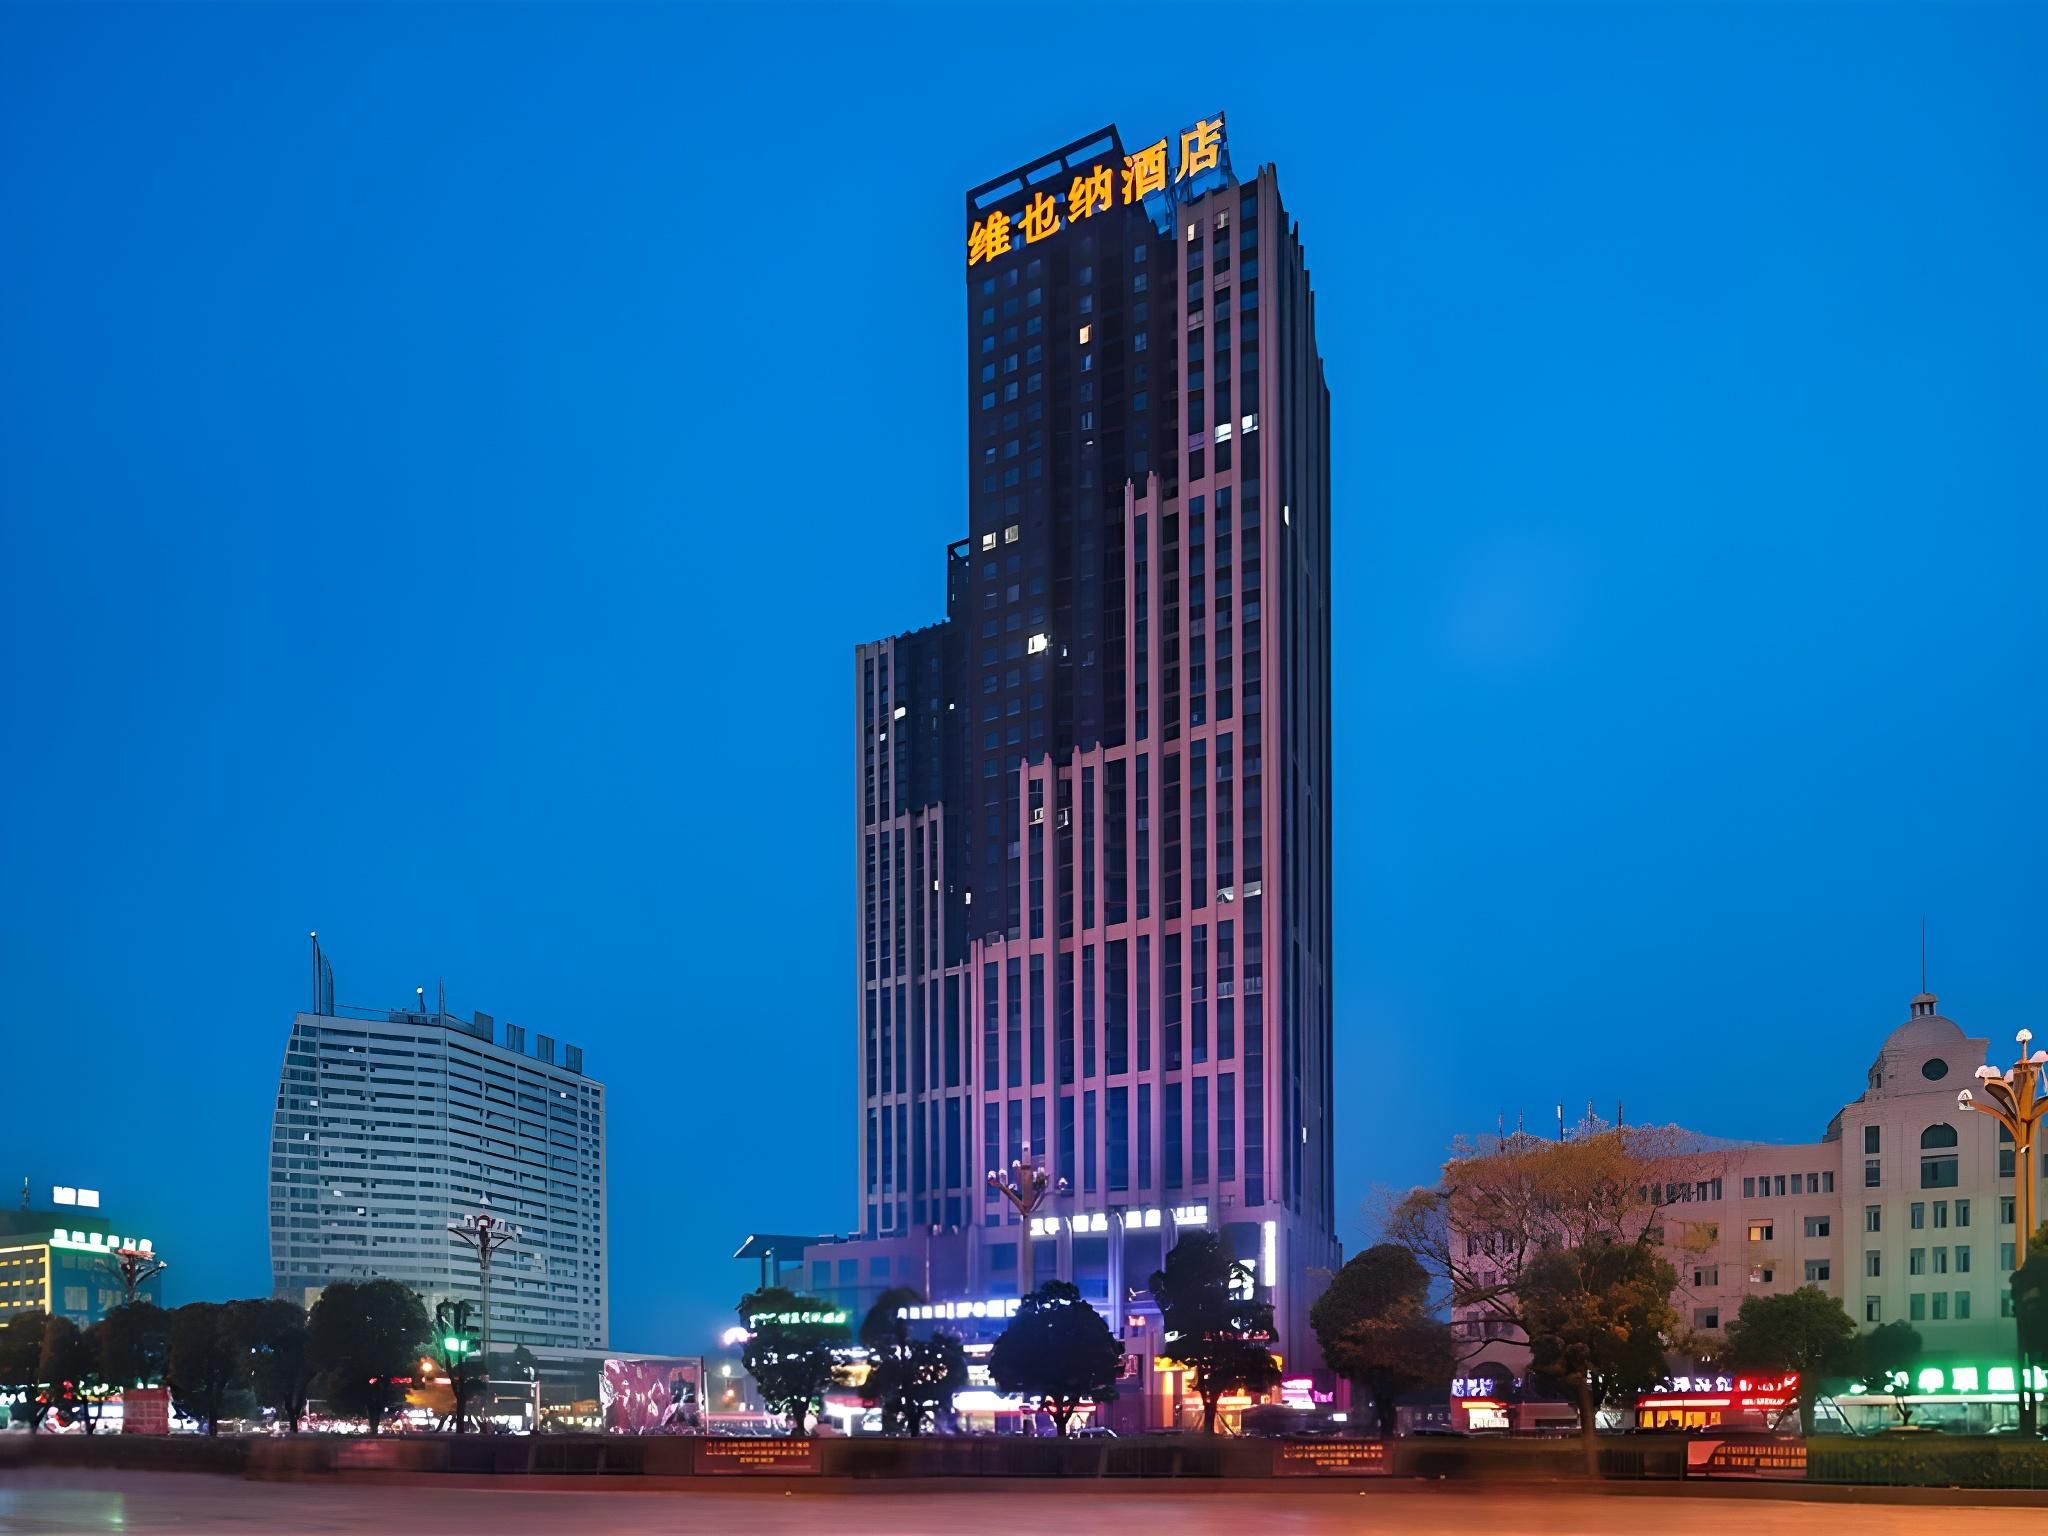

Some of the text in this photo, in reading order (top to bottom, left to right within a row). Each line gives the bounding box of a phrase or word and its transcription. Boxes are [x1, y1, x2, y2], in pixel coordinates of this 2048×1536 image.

[967, 118, 1224, 266] 维也纳酒店
